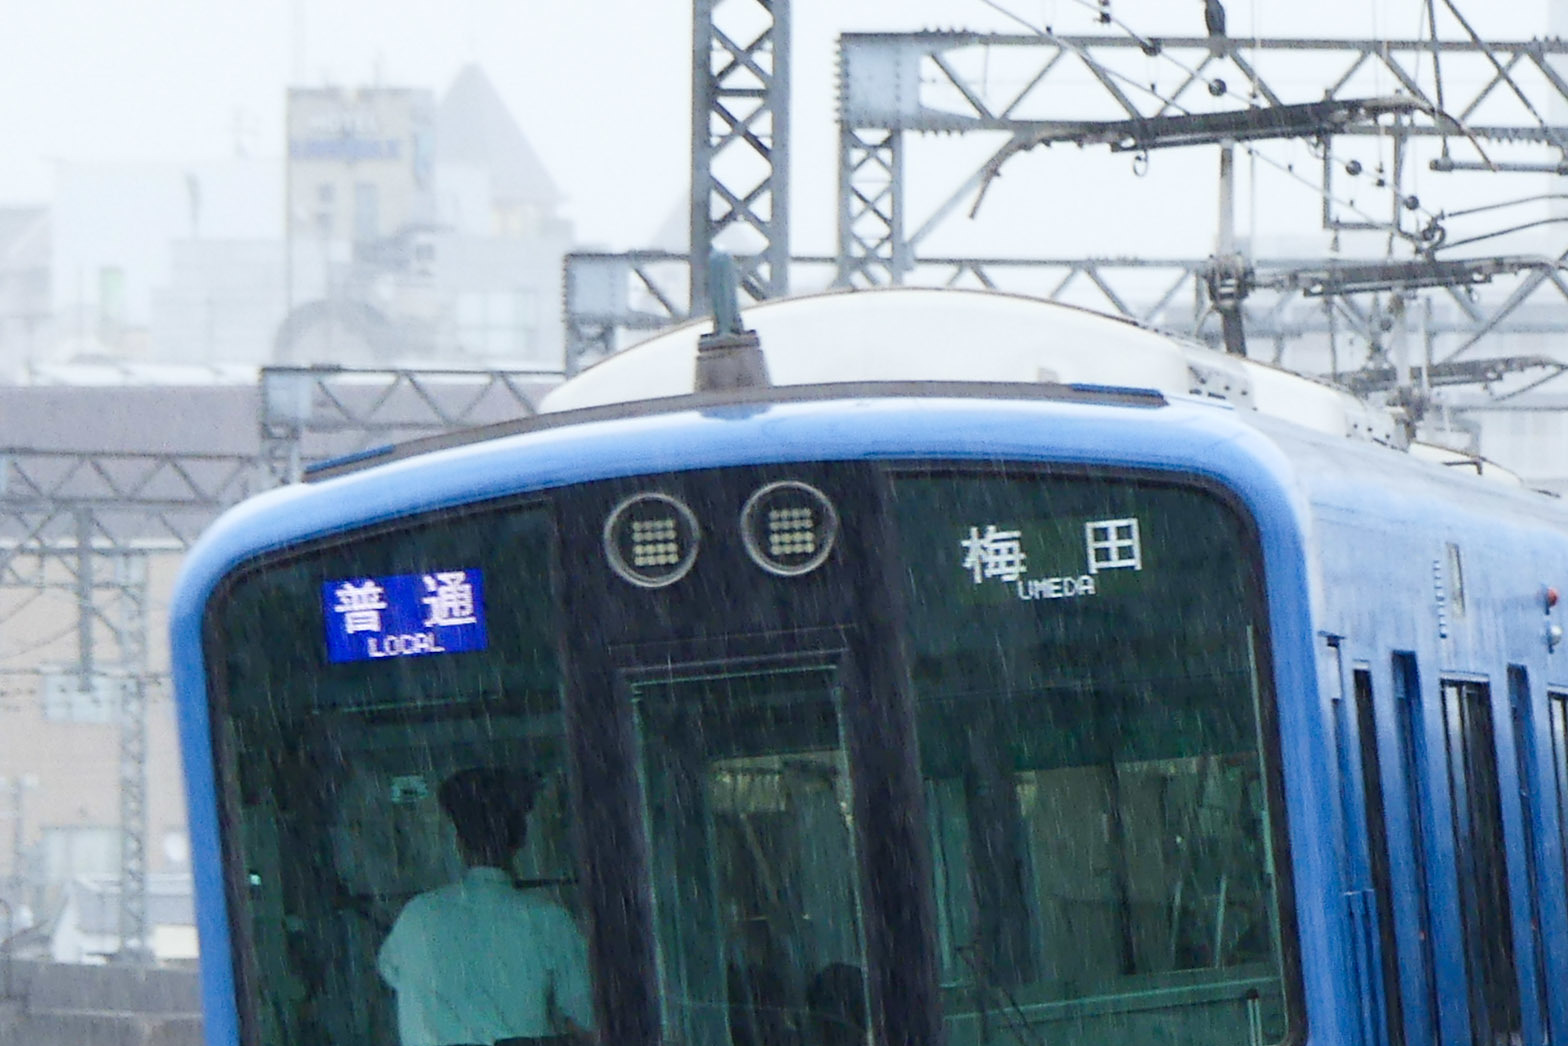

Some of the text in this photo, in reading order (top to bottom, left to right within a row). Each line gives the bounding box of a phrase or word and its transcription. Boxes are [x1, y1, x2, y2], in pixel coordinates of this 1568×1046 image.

[960, 518, 1142, 583] 梅田
[334, 571, 477, 634] 普通
[1017, 575, 1096, 600] UMEDA
[367, 632, 446, 658] LOCAL
